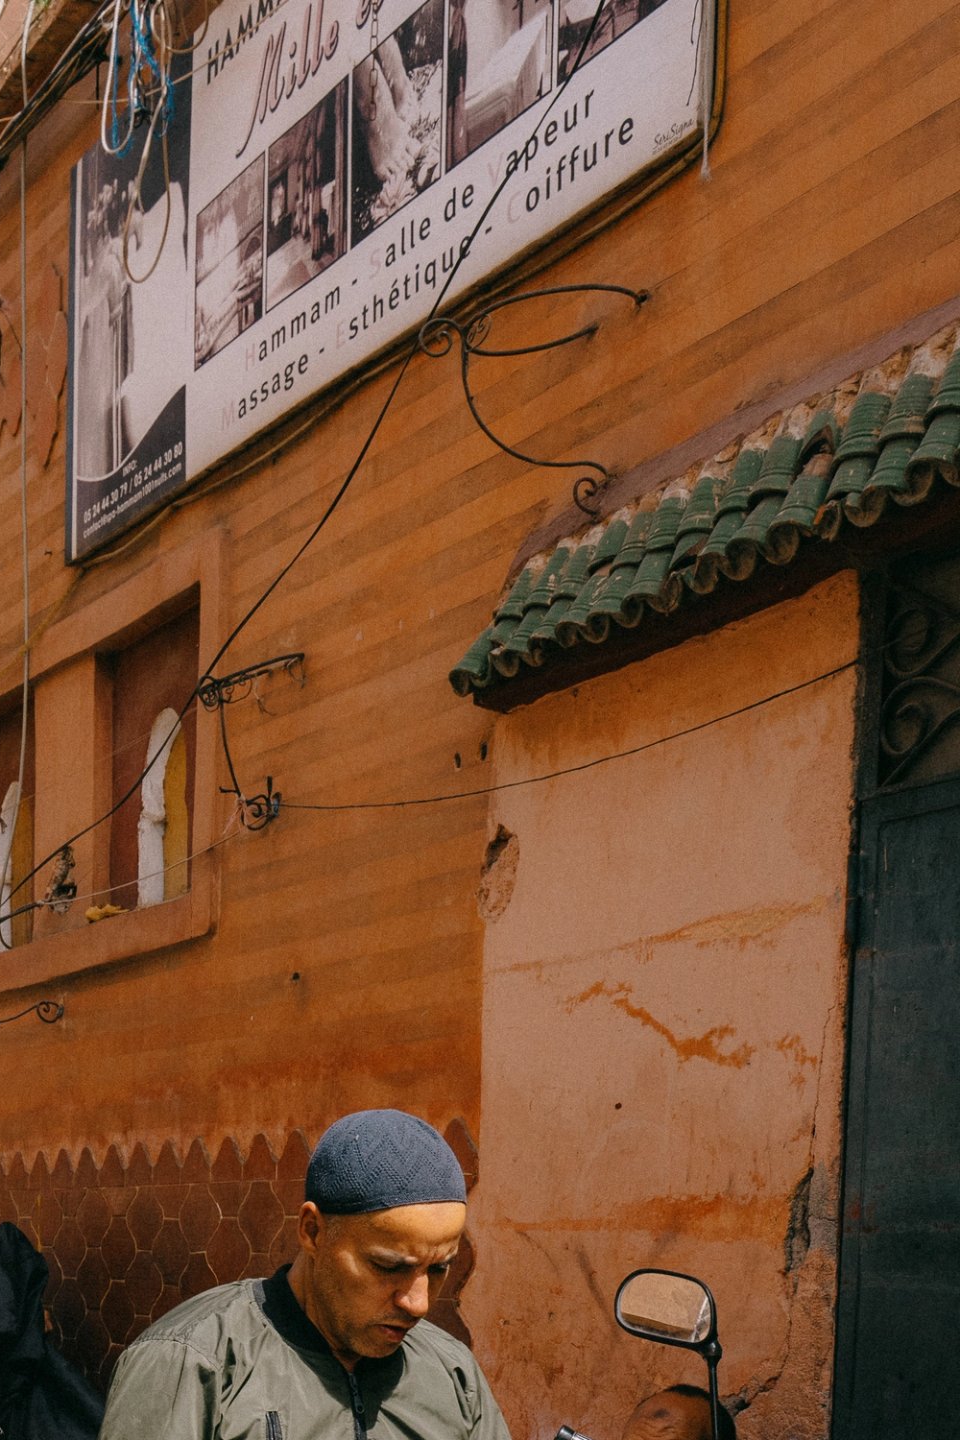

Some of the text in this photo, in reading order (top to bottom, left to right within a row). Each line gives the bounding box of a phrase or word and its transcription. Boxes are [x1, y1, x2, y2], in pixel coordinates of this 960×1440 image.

[207, 0, 281, 85] HAMM
[235, 0, 339, 158] Mille
[222, 354, 309, 431] Massage
[336, 235, 472, 349] Esthétique
[507, 117, 634, 223] Coiffure
[245, 286, 341, 371] Hammam
[369, 217, 431, 279] Salle
[444, 184, 475, 222] de
[487, 89, 595, 185] Vapeur
[164, 449, 173, 466] 30
